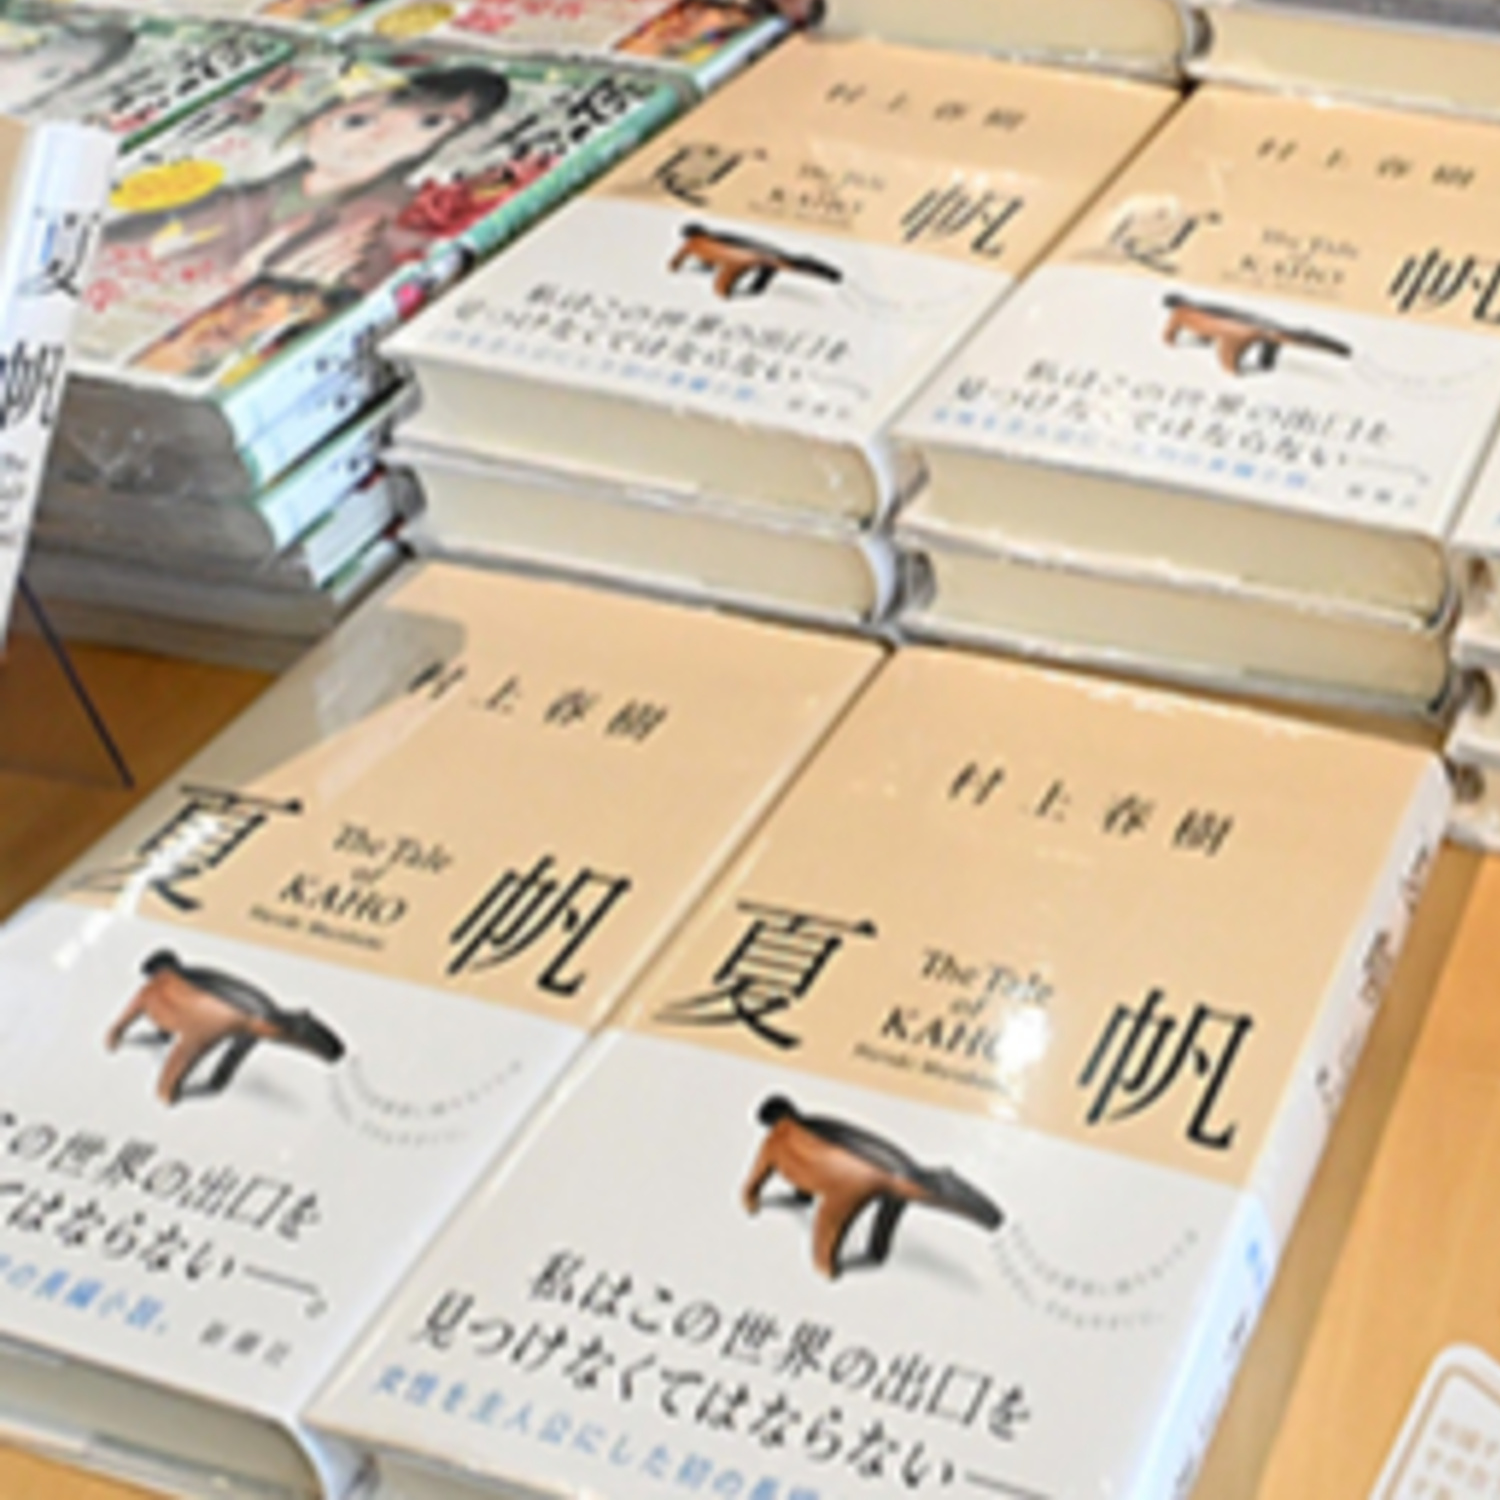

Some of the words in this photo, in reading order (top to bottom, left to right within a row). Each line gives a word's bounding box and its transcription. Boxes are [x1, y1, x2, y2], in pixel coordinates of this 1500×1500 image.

[899, 180, 1027, 259] 帆
[406, 658, 670, 745] 村上春樹
[332, 823, 387, 858] The
[947, 761, 1234, 857] 村上春樹
[70, 780, 304, 912] 夏
[447, 853, 632, 998] 帆
[278, 870, 409, 926] KAHO
[922, 947, 979, 988] The
[653, 899, 876, 1050] 夏
[1079, 986, 1253, 1150] 帆
[0, 1112, 322, 1241] の世界の出口を
[529, 1252, 1033, 1443] 私はこの世界の出口を
